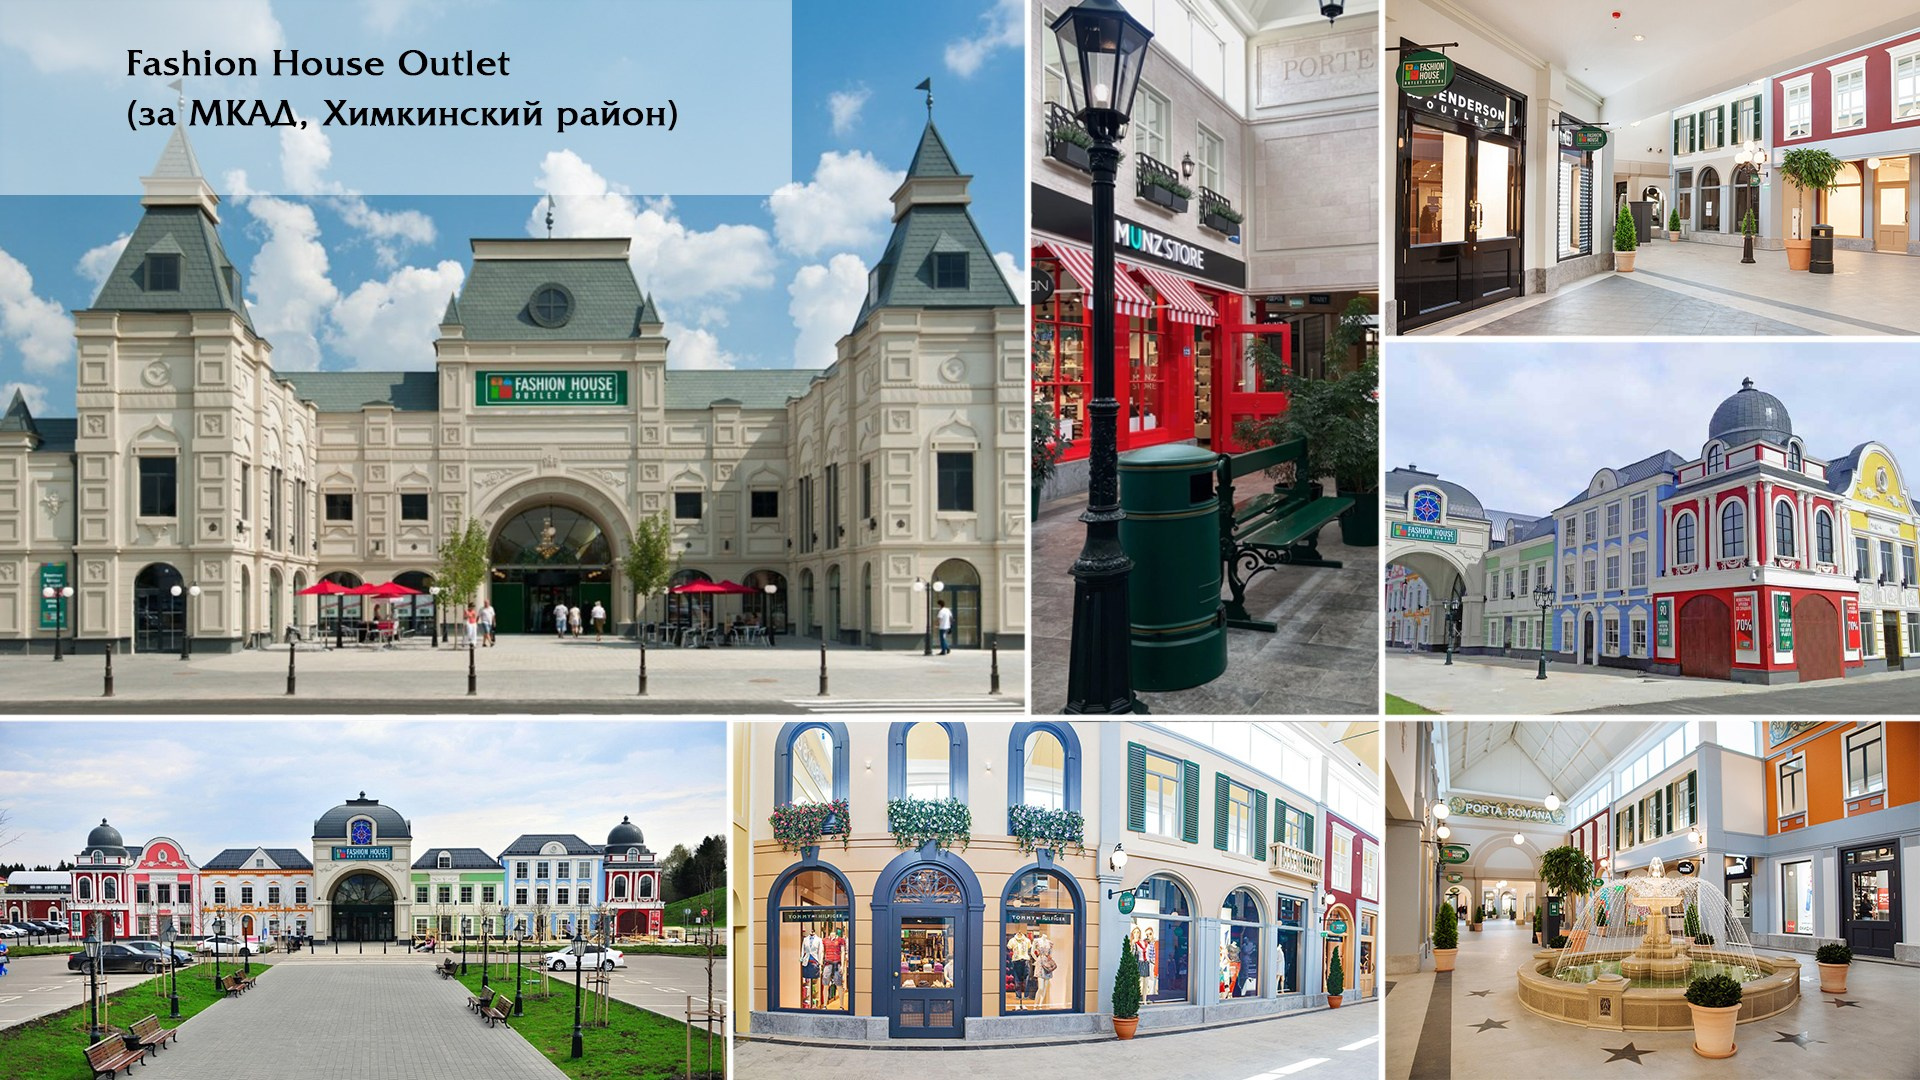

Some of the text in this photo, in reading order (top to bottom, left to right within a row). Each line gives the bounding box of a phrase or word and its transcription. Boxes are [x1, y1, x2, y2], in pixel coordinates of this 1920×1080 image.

[1283, 48, 1375, 81] PORTE
[1420, 62, 1445, 71] FASHION
[1420, 71, 1440, 80] HOUSE
[1427, 101, 1488, 126] OUTLET
[1115, 219, 1205, 270] MUNZ STORE
[515, 377, 613, 391] FASHION HOUSE
[515, 392, 613, 400] OUTLET CENTRE
[1408, 526, 1454, 538] FASHION HOUSE
[1660, 605, 1667, 615] 90
[1781, 600, 1789, 613] 90
[1736, 619, 1752, 631] 70%
[1465, 803, 1552, 821] PORTA ROMANA
